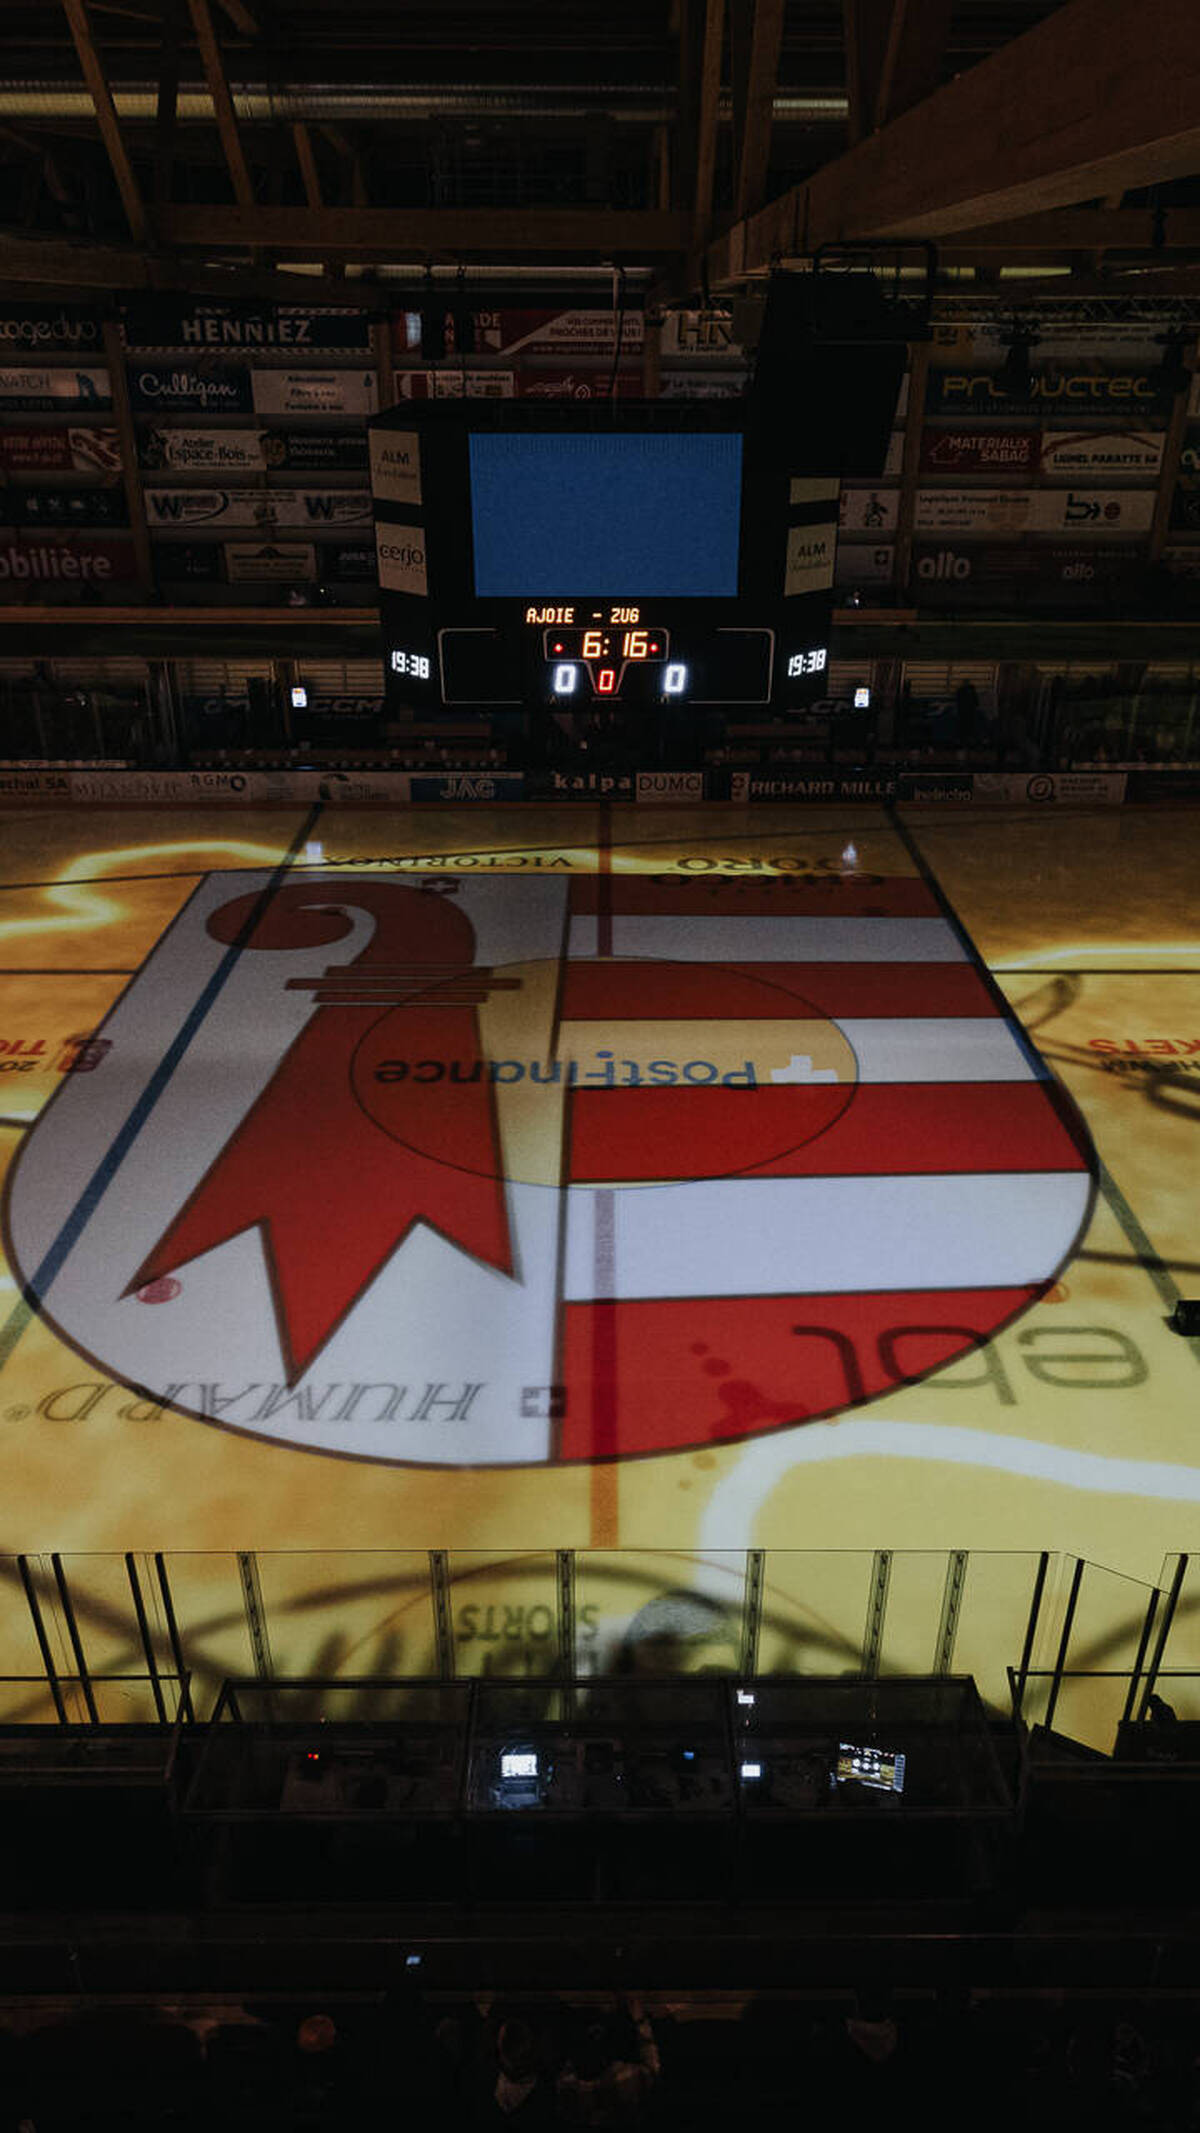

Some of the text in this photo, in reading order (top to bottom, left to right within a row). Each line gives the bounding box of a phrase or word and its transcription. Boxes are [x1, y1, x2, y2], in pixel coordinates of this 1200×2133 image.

[181, 319, 313, 344] HENNIEZ
[138, 371, 240, 407] Culligan
[526, 607, 575, 624] AJOIE
[610, 607, 640, 624] ZUG
[391, 650, 430, 680] 19:38
[553, 663, 576, 692] 0
[664, 663, 687, 692] 0
[787, 648, 828, 678] 19:38
[598, 669, 614, 691] 0
[554, 771, 632, 792] kalpa
[750, 780, 835, 794] RICHARD
[840, 780, 896, 794] MILLE
[374, 1052, 758, 1090] PostFinance
[458, 1604, 598, 1643] SORTS
